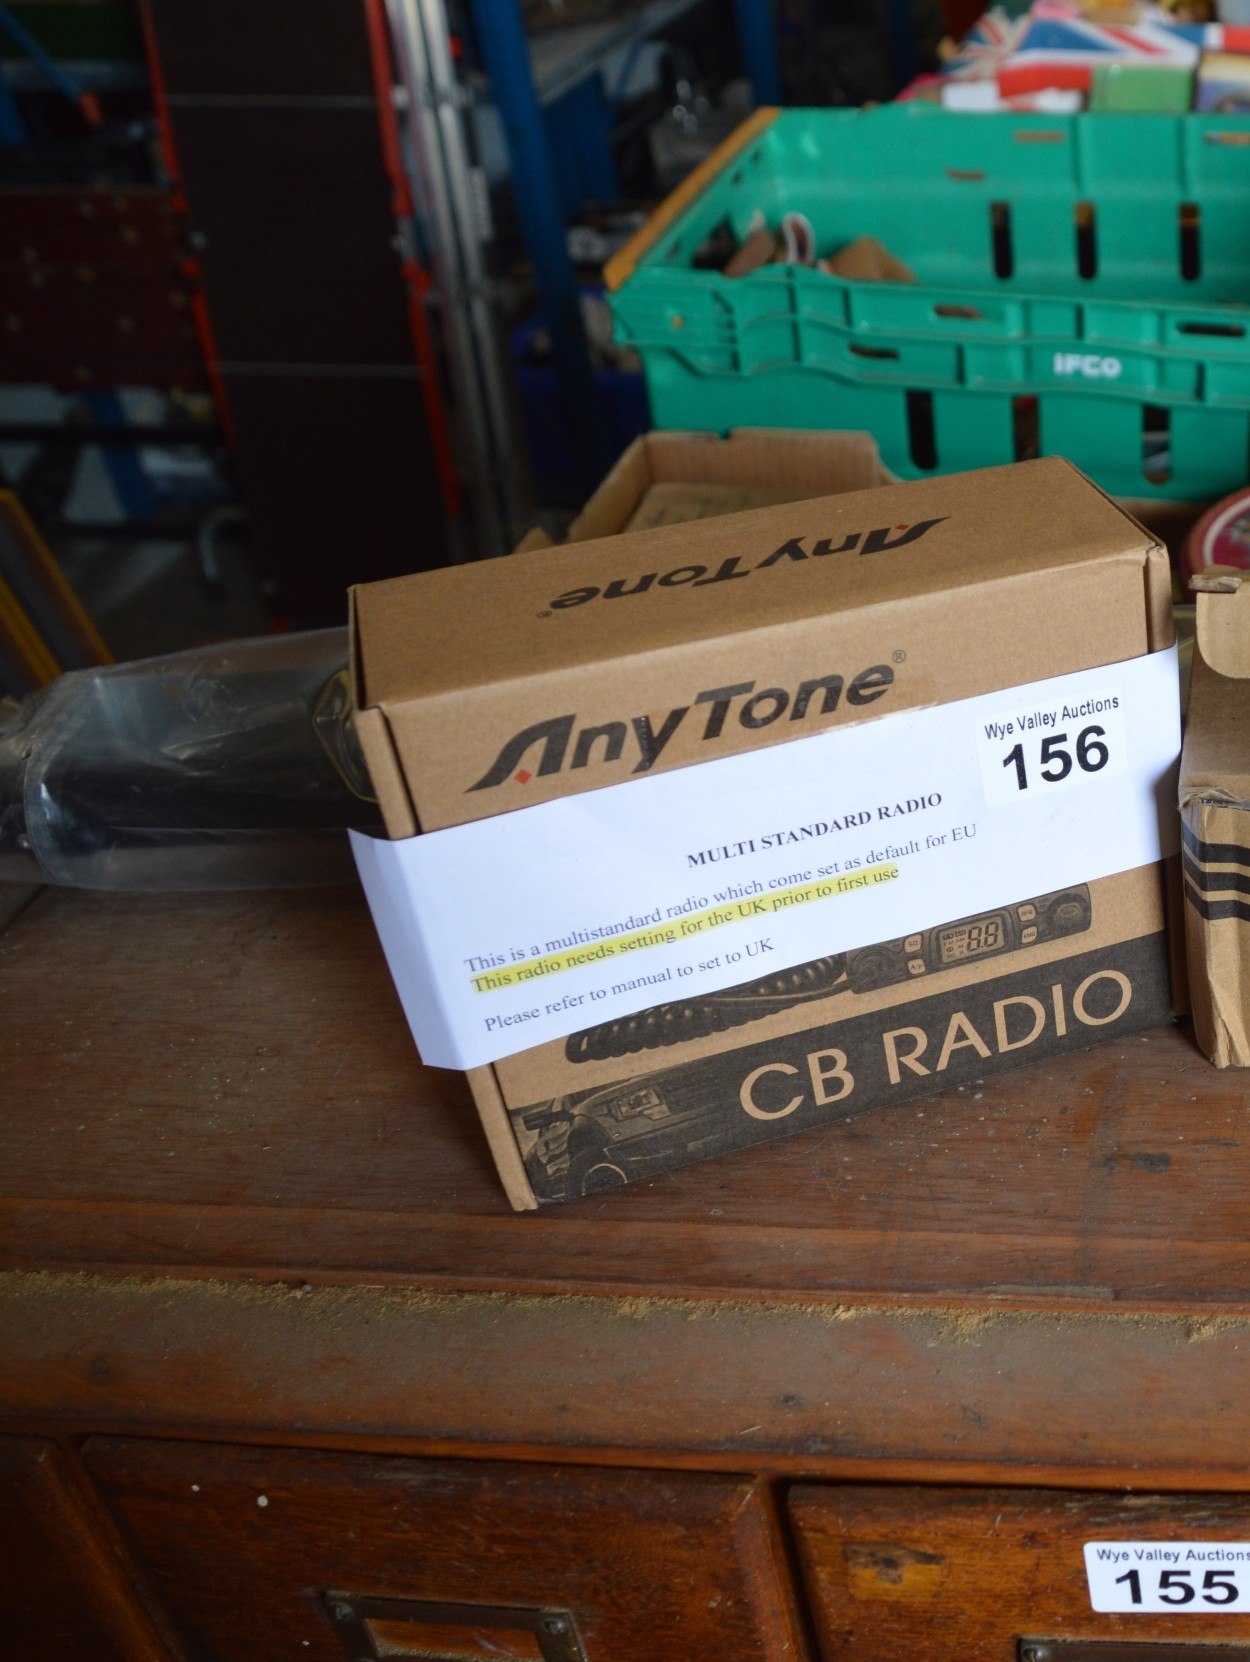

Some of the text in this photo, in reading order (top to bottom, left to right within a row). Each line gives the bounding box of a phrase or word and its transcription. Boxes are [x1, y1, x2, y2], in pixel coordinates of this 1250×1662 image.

[1053, 352, 1122, 379] IFCO
[550, 516, 951, 609] AnyTone
[464, 664, 894, 793] AnyTone
[984, 697, 1119, 740] Wye Valley Auctions
[1002, 725, 1109, 790] 156
[687, 792, 943, 868] MULTI STANDARD RADIO
[464, 824, 977, 973] This is a multistandard radio which come set as default for EU
[471, 867, 900, 993] This radio needs setting for the UK prior to first use
[484, 937, 775, 1032] Please refer to manual to set to UK
[739, 969, 1133, 1121] CB RADIO
[1097, 1549, 1129, 1563] Wye
[1134, 1549, 1180, 1563] Valley
[1115, 1569, 1239, 1605] 155
